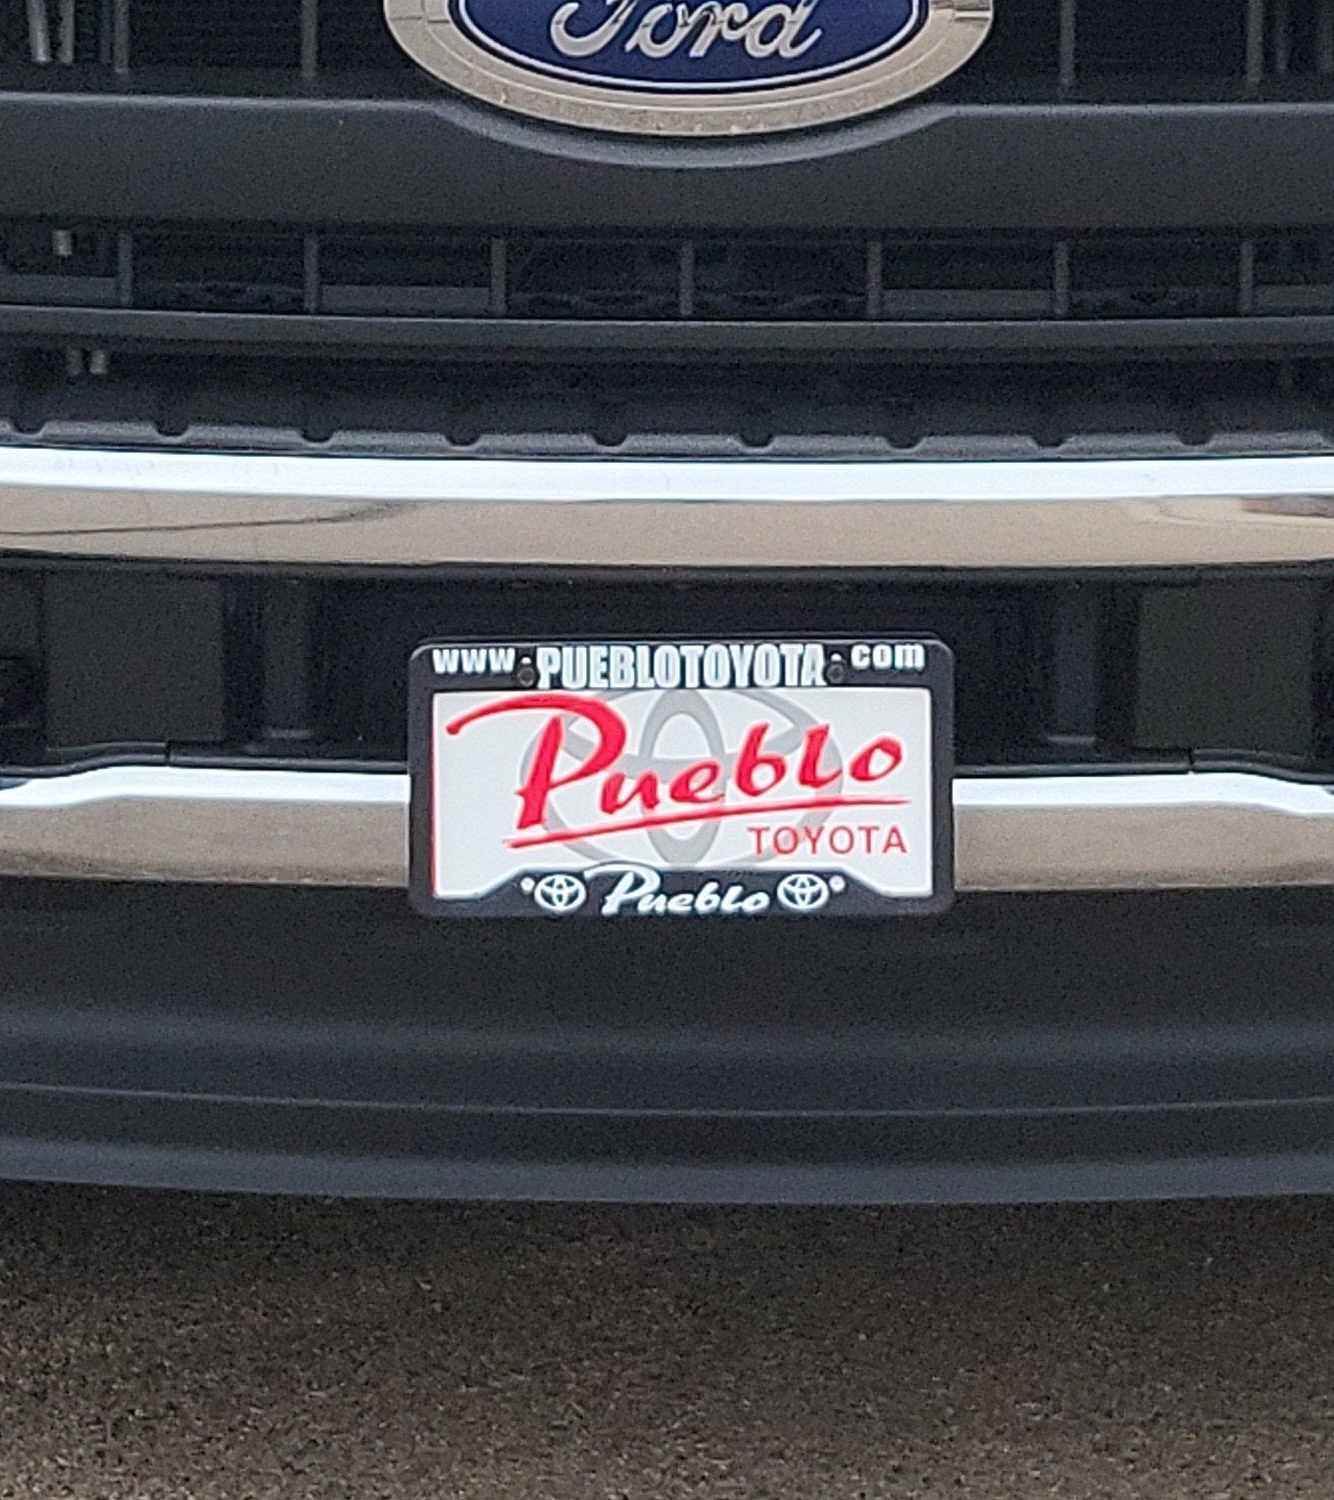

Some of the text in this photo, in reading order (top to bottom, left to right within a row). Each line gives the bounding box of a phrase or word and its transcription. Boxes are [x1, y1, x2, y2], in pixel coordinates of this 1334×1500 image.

[536, 643, 827, 689] PUEBLOTOYOTA
[445, 692, 904, 831] Pueblo
[747, 826, 907, 855] TOYOTA
[584, 867, 770, 916] Pueblo
